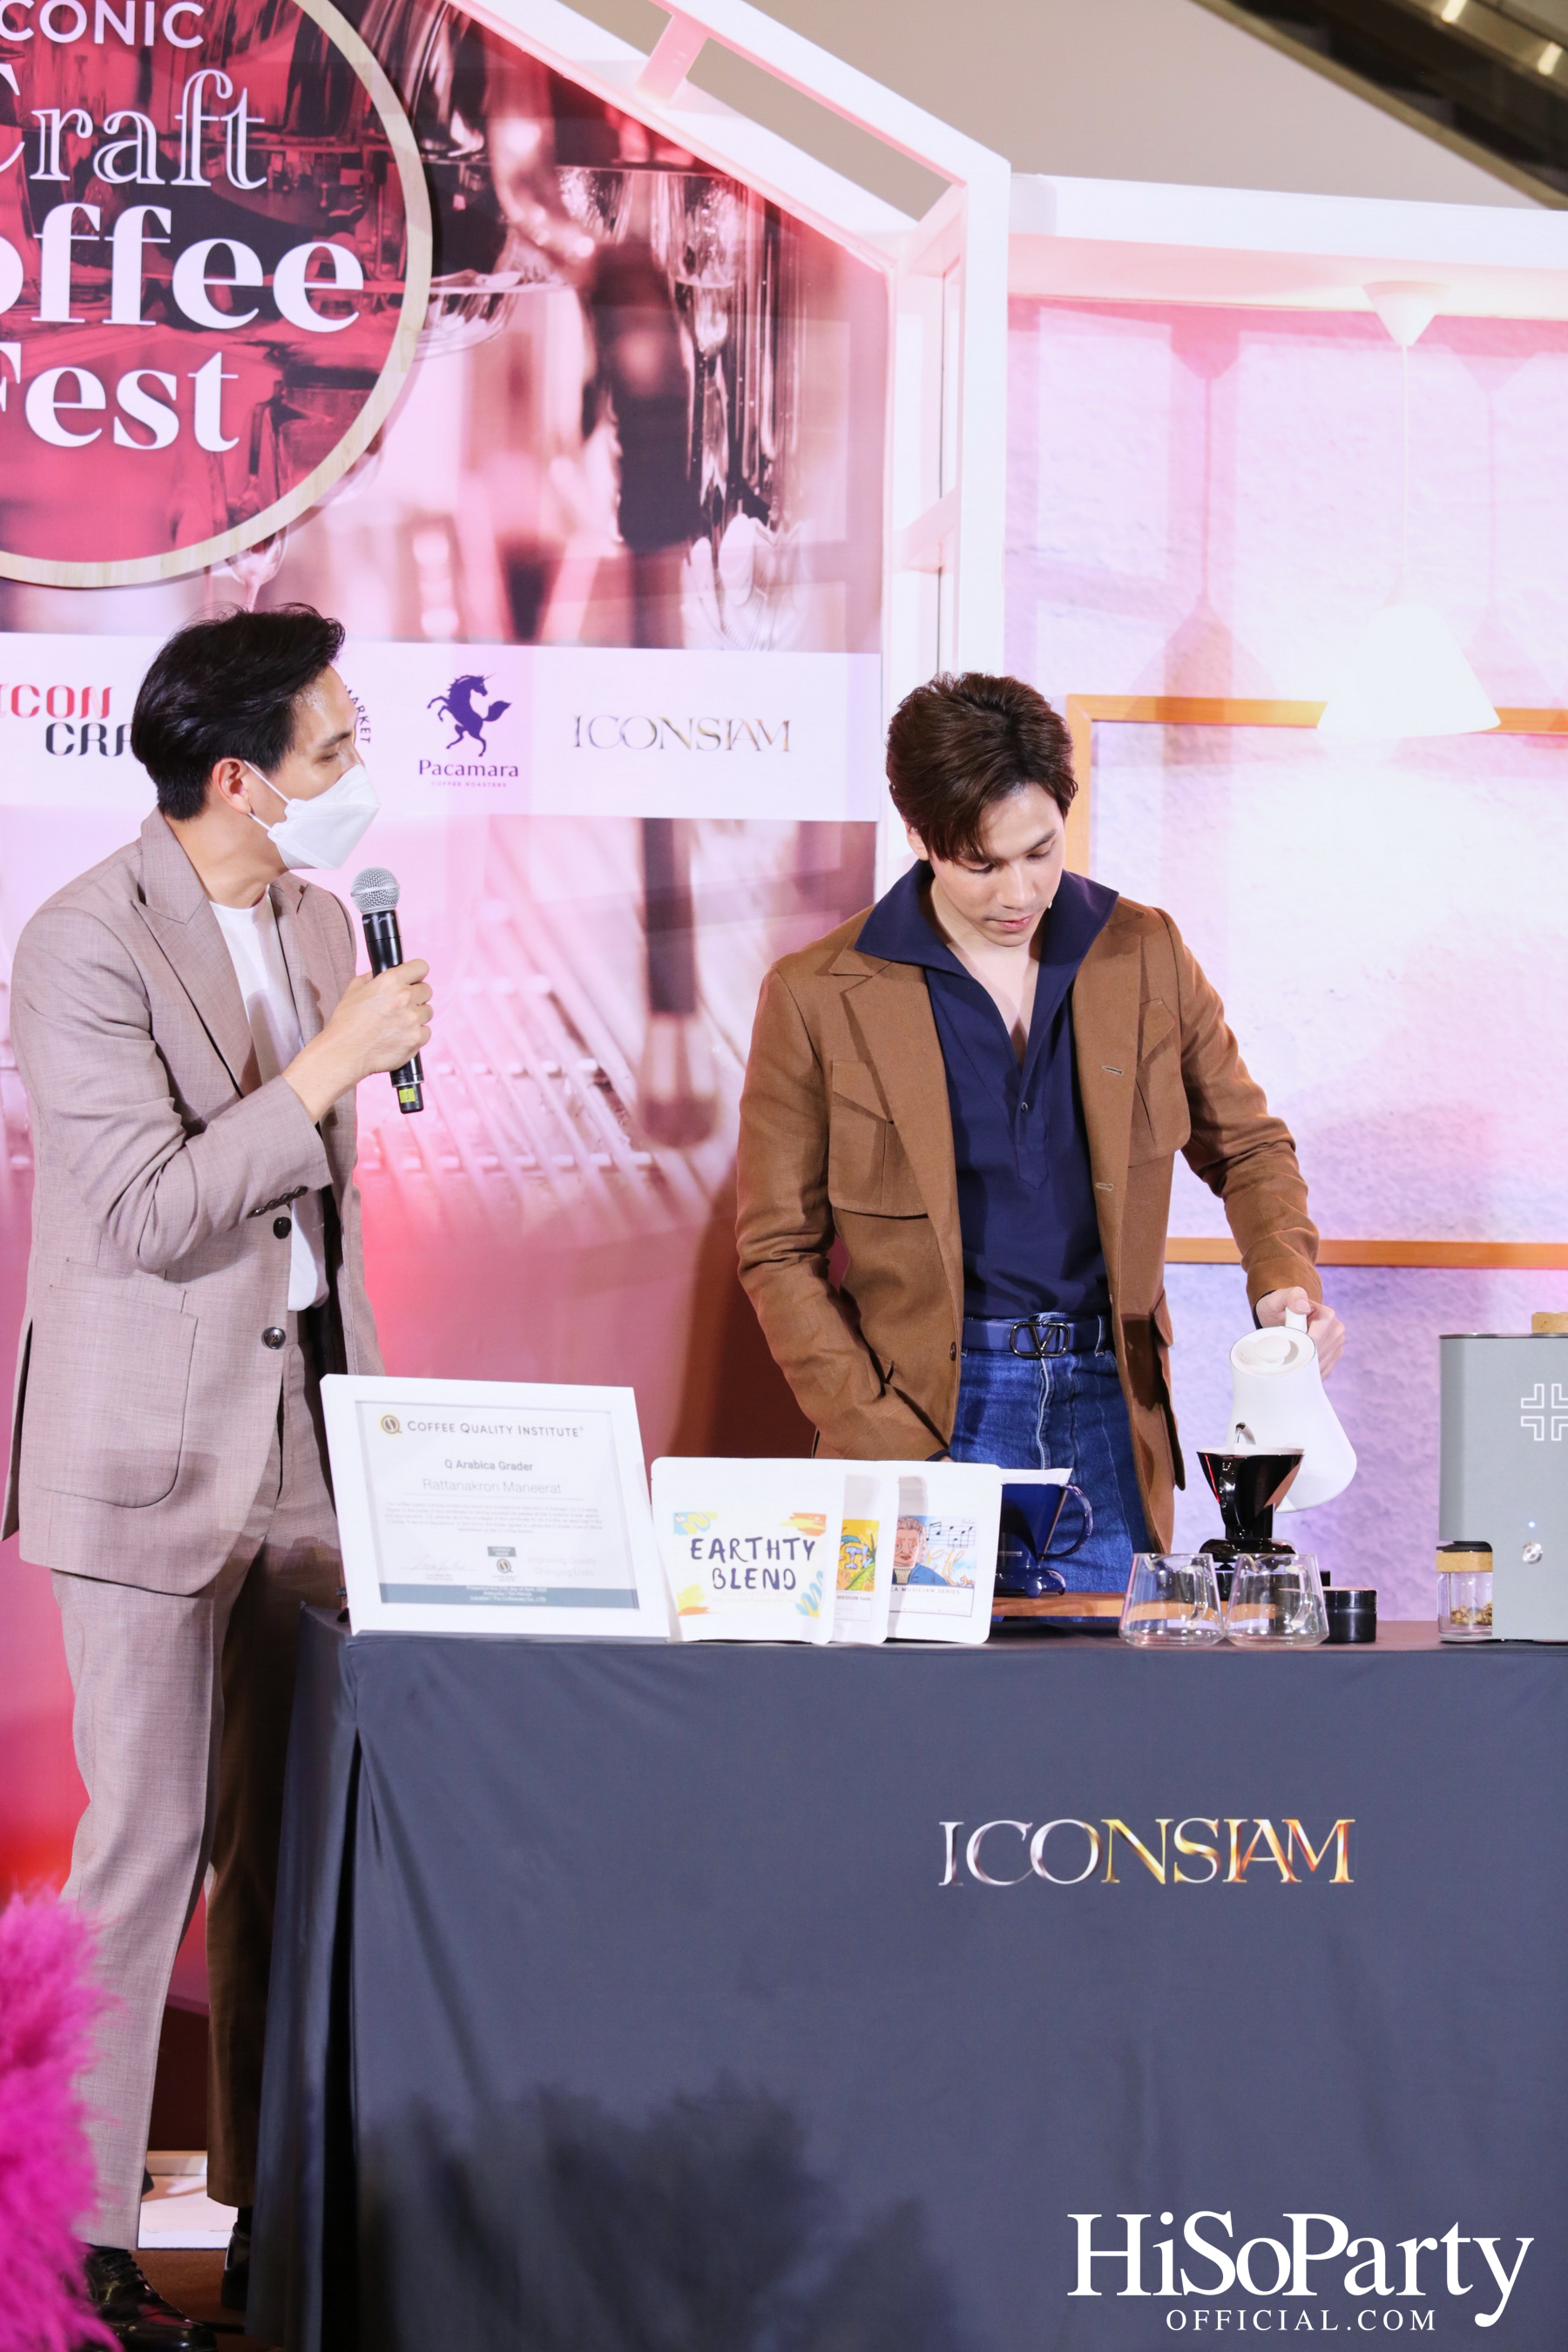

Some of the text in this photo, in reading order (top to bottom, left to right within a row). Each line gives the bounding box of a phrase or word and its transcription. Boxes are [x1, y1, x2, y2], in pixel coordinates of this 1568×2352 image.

[0, 202, 365, 334] ffee
[0, 341, 240, 453] est
[572, 714, 791, 753] ICONSIAM
[418, 759, 519, 777] Pacamara
[407, 1420, 580, 1438] COFFEE QUALITY INSTITUTE
[456, 1459, 496, 1470] Arabica
[498, 1461, 533, 1471] Grader
[690, 1537, 816, 1564] EARTHTY
[712, 1567, 797, 1591] BLEND
[938, 1817, 1356, 1887] ICONSIAM
